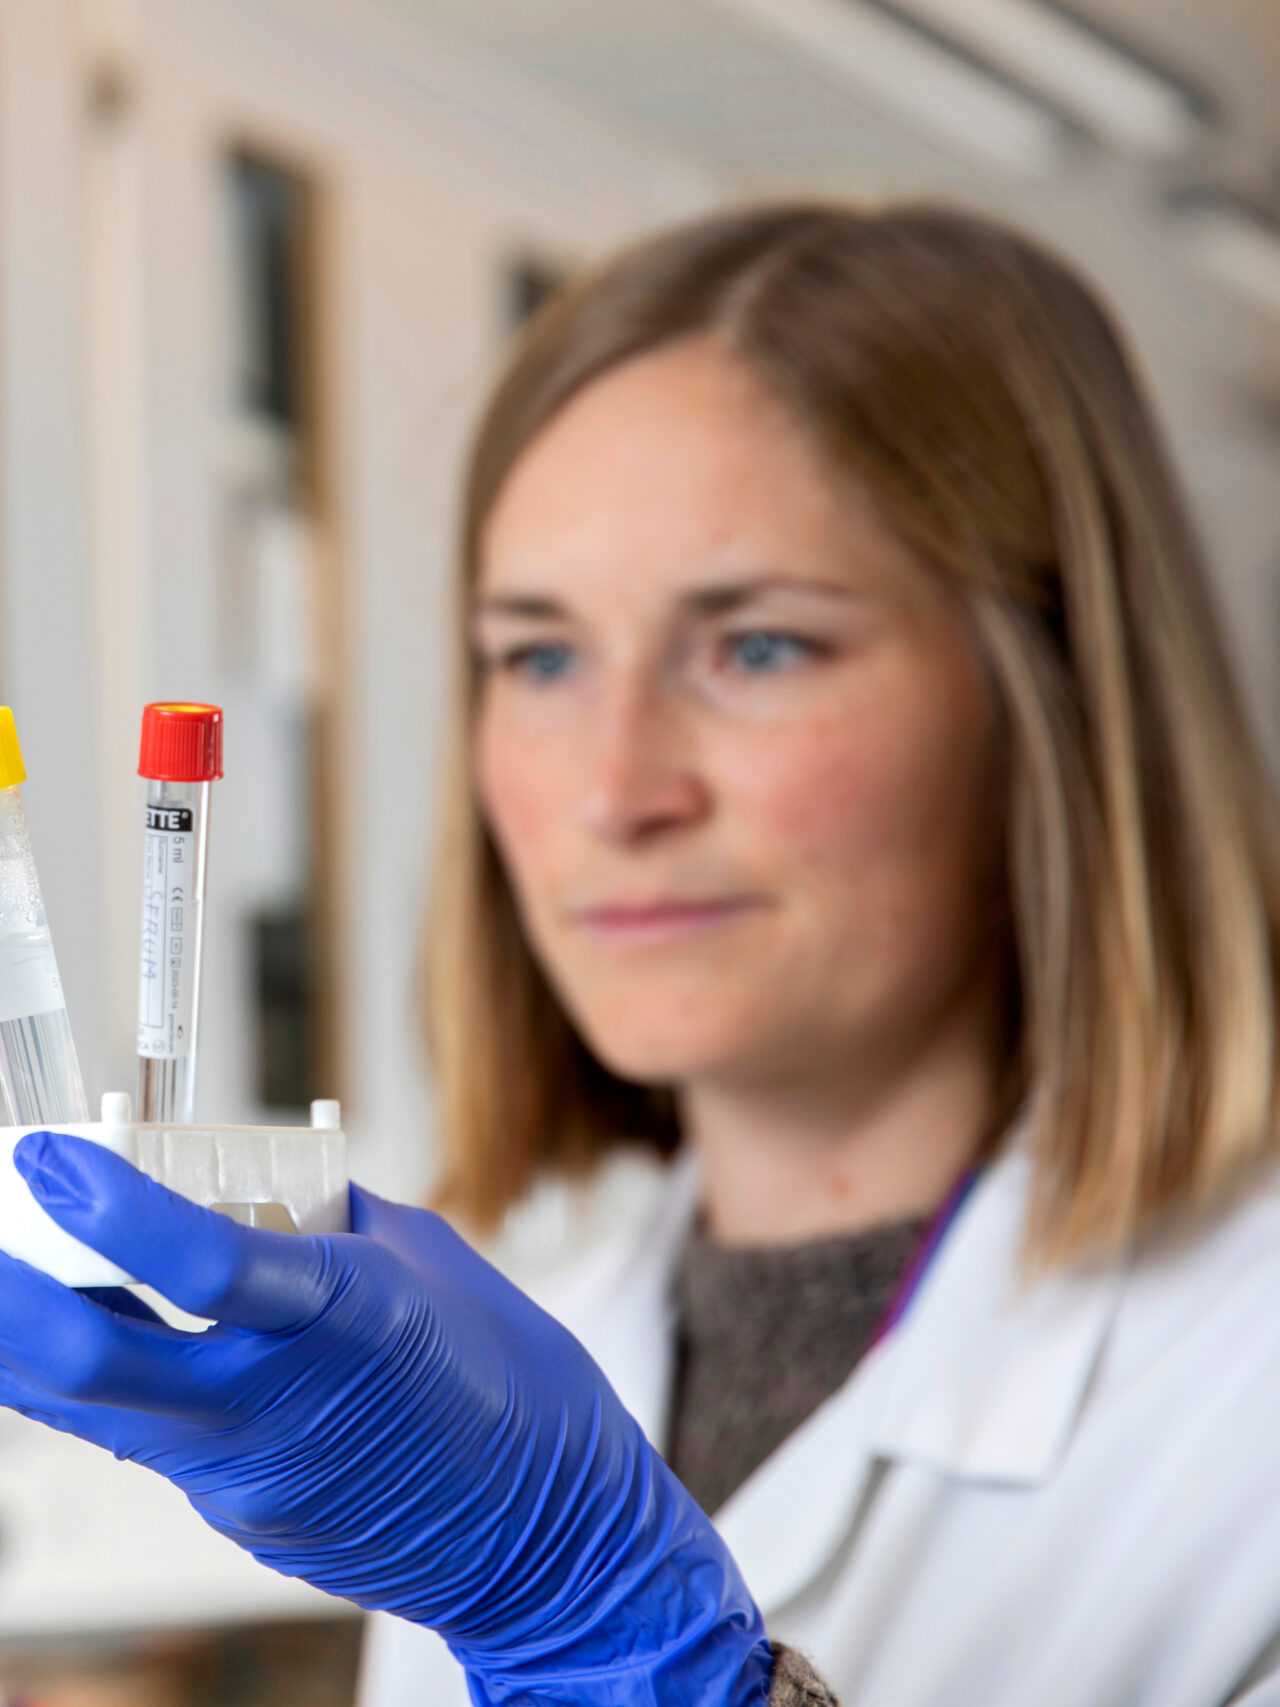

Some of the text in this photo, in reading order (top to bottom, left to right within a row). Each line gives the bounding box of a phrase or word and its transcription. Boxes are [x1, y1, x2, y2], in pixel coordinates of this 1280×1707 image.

[173, 836, 185, 863] 5 ml
[141, 885, 164, 979] SERUM
